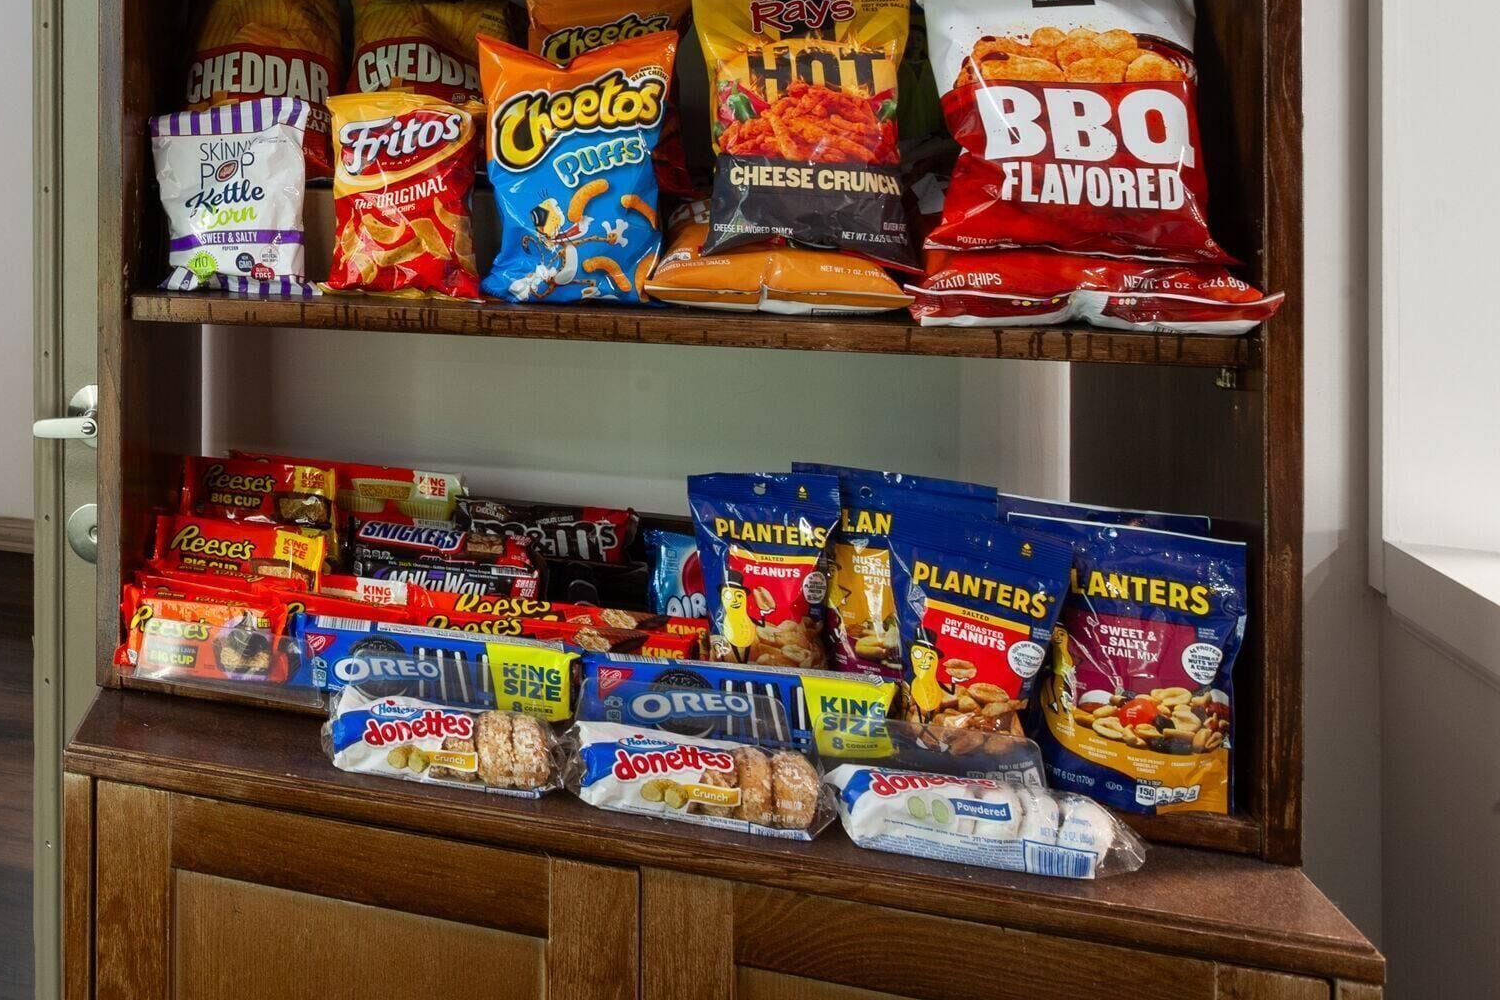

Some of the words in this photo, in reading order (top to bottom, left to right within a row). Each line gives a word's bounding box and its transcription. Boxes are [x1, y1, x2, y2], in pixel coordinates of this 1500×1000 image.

[187, 51, 330, 104] CHEDDAR
[630, 72, 647, 82] REAL
[747, 48, 886, 106] HOT
[496, 72, 662, 169] Cheetos
[975, 86, 1195, 168] BBQ
[339, 113, 461, 176] Fritos
[381, 155, 419, 166] BRAND
[201, 152, 255, 190] POP
[729, 166, 814, 189] CHEESE
[817, 169, 901, 196] CRUNCH
[1001, 161, 1186, 210] FLAVORED
[185, 180, 265, 215] Kettle
[354, 198, 373, 210] The
[376, 175, 448, 208] ORIGINAL
[201, 206, 258, 229] Corn
[713, 223, 737, 233] CHEESE
[737, 224, 770, 234] FLAVORED
[770, 226, 794, 236] SNACK
[841, 230, 854, 240] NET
[856, 231, 868, 241] WT.
[202, 232, 225, 245] SWEET
[227, 232, 234, 242] &
[233, 231, 258, 243] SALTY
[957, 236, 987, 245] POTATO
[820, 265, 833, 273] NET
[967, 272, 1002, 286] CHIPS
[204, 463, 275, 493] Reese's
[301, 472, 325, 481] KING
[301, 480, 325, 489] SIZE
[419, 475, 446, 487] KING
[419, 485, 446, 497] SIZE
[211, 493, 232, 504] BIG
[233, 496, 261, 507] CUP
[360, 521, 466, 549] SNICKERS
[714, 518, 827, 549] PLANTERS
[171, 525, 255, 560] Reese's
[283, 538, 309, 551] KING
[282, 546, 307, 560] SIZE
[760, 555, 785, 563] SALTED
[745, 564, 801, 579] PEANUTS
[363, 584, 392, 596] KING
[443, 572, 487, 596] Way
[912, 561, 1048, 619] PLANTERS
[520, 588, 536, 597] SIZE
[131, 604, 211, 641] Reese's
[961, 609, 990, 621] SALTED
[666, 623, 708, 637] KING
[944, 617, 963, 629] DRY
[964, 622, 1004, 640] ROASTED
[1099, 624, 1143, 640] SWEET
[1147, 630, 1157, 642] &
[940, 623, 1007, 651] PEANUTS
[1109, 637, 1149, 651] SALTY
[170, 654, 194, 665] CUP
[641, 646, 685, 660] KING
[1100, 645, 1135, 660] TRAIL
[1136, 650, 1159, 663] MIX
[335, 657, 439, 680] OREO
[502, 662, 561, 685] KING
[502, 679, 562, 702] SIZE
[512, 701, 523, 712] 8
[524, 705, 554, 714] COOKIES
[631, 692, 749, 719] OREO
[820, 696, 886, 718] KING
[363, 711, 474, 746] donettes
[822, 716, 887, 738] SIZE
[625, 737, 669, 748] Hostess
[832, 737, 844, 750] 8
[846, 742, 879, 750] COOKIES
[433, 754, 466, 766] Crunch
[613, 747, 735, 782] donettes
[1067, 770, 1076, 782] OZ
[692, 788, 729, 802] Crunch
[1138, 786, 1155, 797] 150
[956, 801, 1007, 818] Powdered
